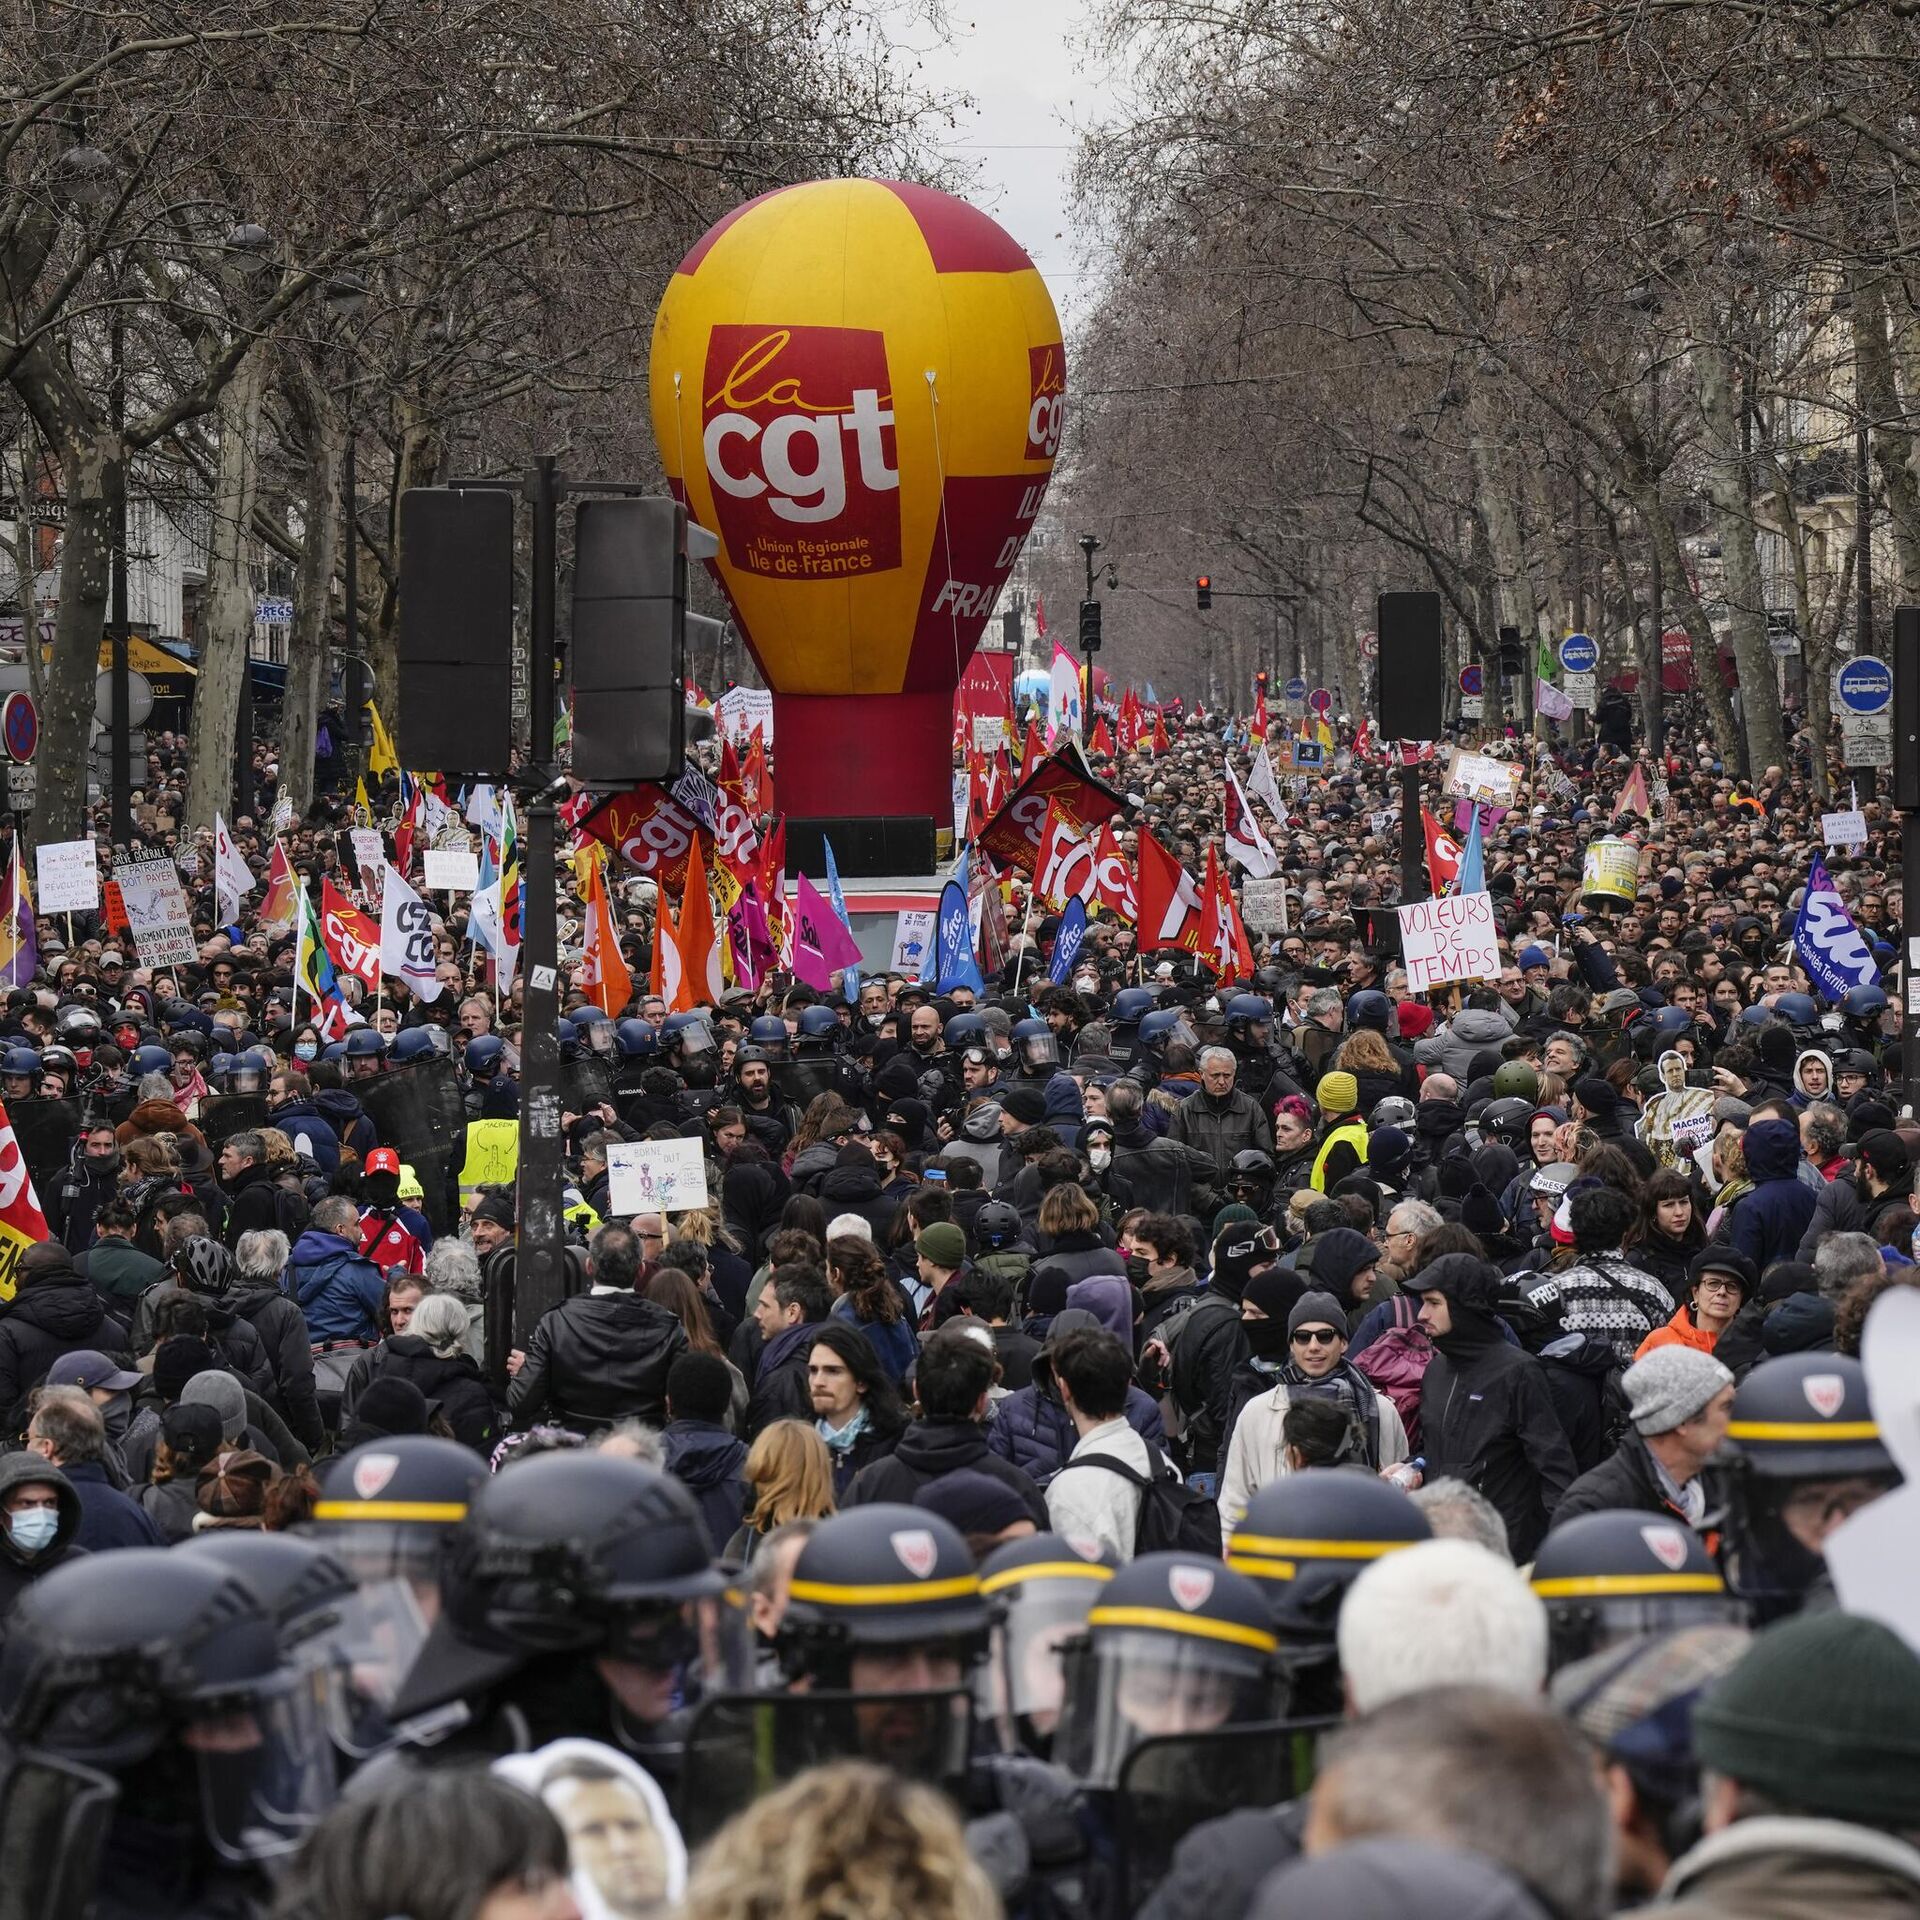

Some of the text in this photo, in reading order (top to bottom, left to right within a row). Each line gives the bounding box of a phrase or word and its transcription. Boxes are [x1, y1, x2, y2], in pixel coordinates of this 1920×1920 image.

[1028, 393, 1065, 457] cg
[703, 388, 900, 524] cgt
[757, 536, 870, 557] Union Régionale
[931, 579, 1002, 618] FRA
[621, 801, 698, 872] cgt
[117, 860, 173, 878] LE PATRONAT
[121, 871, 174, 888] DOIT PAYER
[1399, 894, 1491, 936] VOLEURS
[134, 926, 190, 944] AUGMENTATION
[948, 908, 963, 950] cftc
[137, 937, 194, 956] DES SALAIRES ET
[326, 913, 382, 979] cgt
[1061, 922, 1083, 961] cftc
[1434, 929, 1465, 954] DE
[143, 955, 156, 967] DES
[1408, 948, 1496, 986] TEMPS
[1491, 1116, 1505, 1128] TV
[634, 1146, 662, 1158] BORNE
[663, 1152, 681, 1164] OUT
[400, 1187, 421, 1197] PARIS
[1537, 1179, 1566, 1193] PRESS
